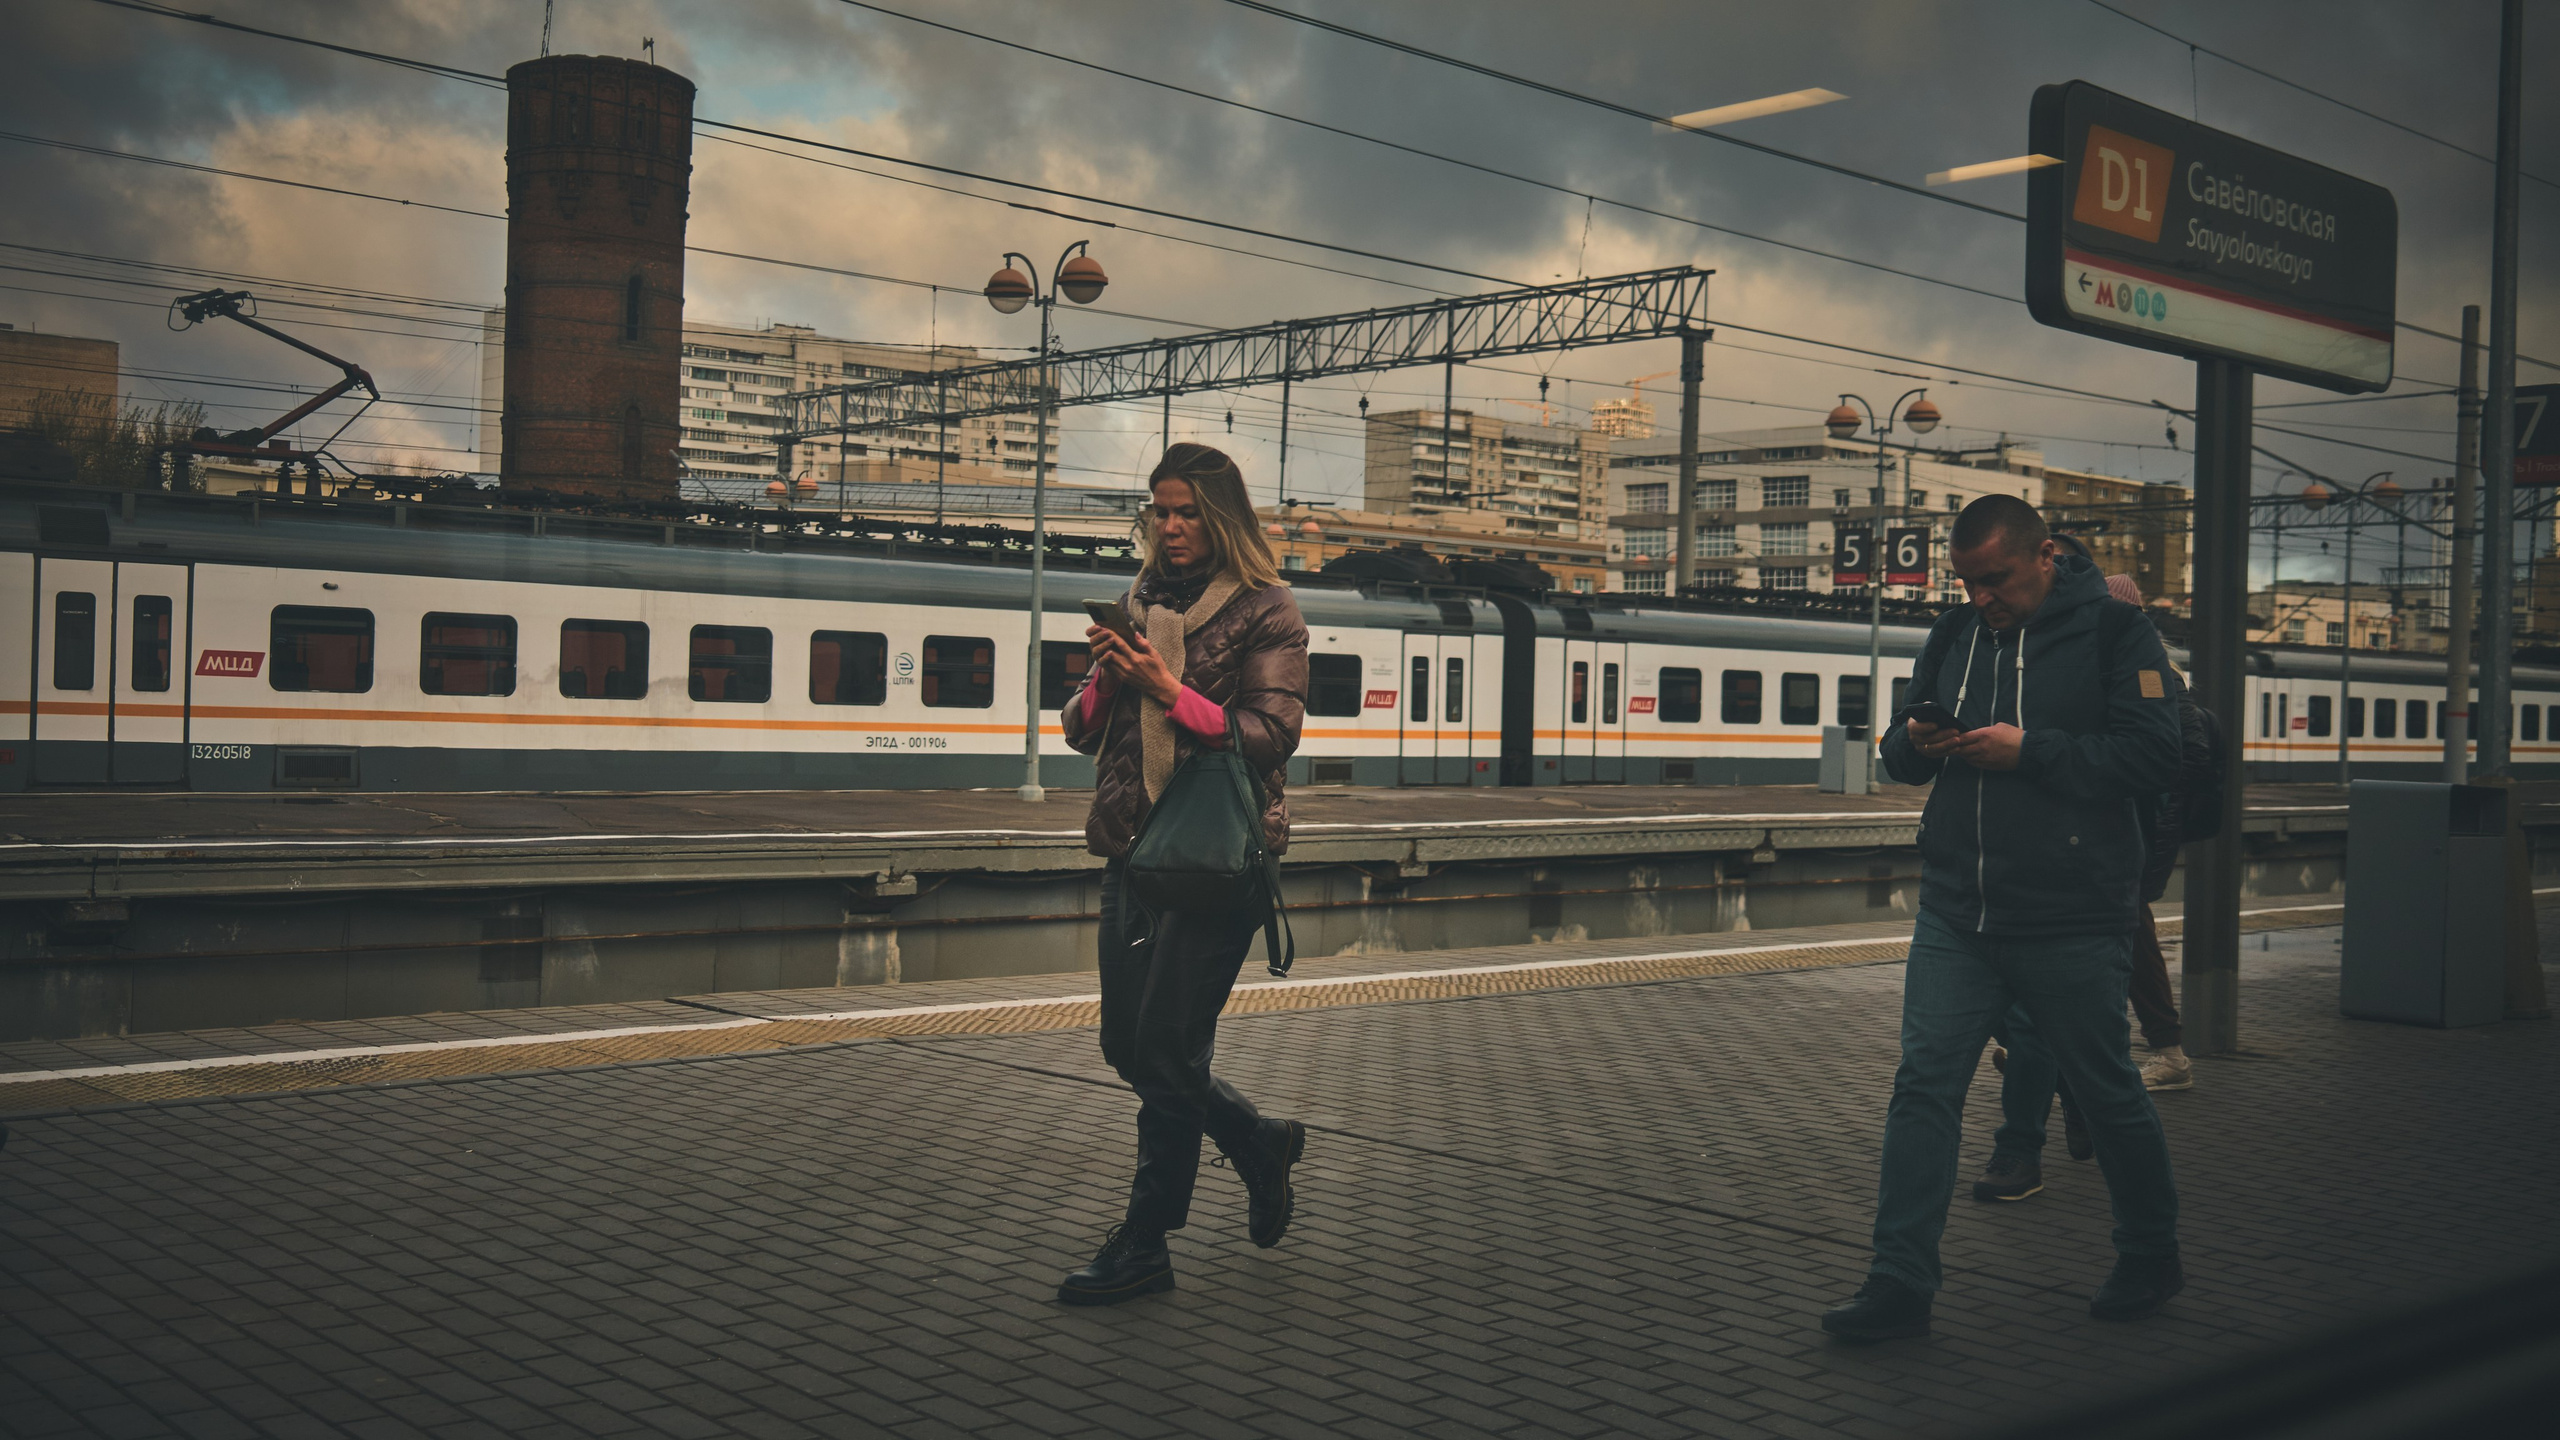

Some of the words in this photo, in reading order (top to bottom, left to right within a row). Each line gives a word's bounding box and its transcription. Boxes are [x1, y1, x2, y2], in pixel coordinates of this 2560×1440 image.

[2098, 146, 2152, 222] D1
[2187, 161, 2335, 242] Савёловская
[2186, 217, 2313, 284] Savyolovskaya
[2514, 395, 2548, 449] 7
[2534, 462, 2560, 472] Trac
[1843, 535, 1860, 567] 5
[1897, 534, 1919, 567] 6
[205, 655, 254, 672] МЦД
[192, 745, 251, 760] 13260518
[866, 736, 898, 748] ЭП2Д
[909, 737, 947, 748] 001906
